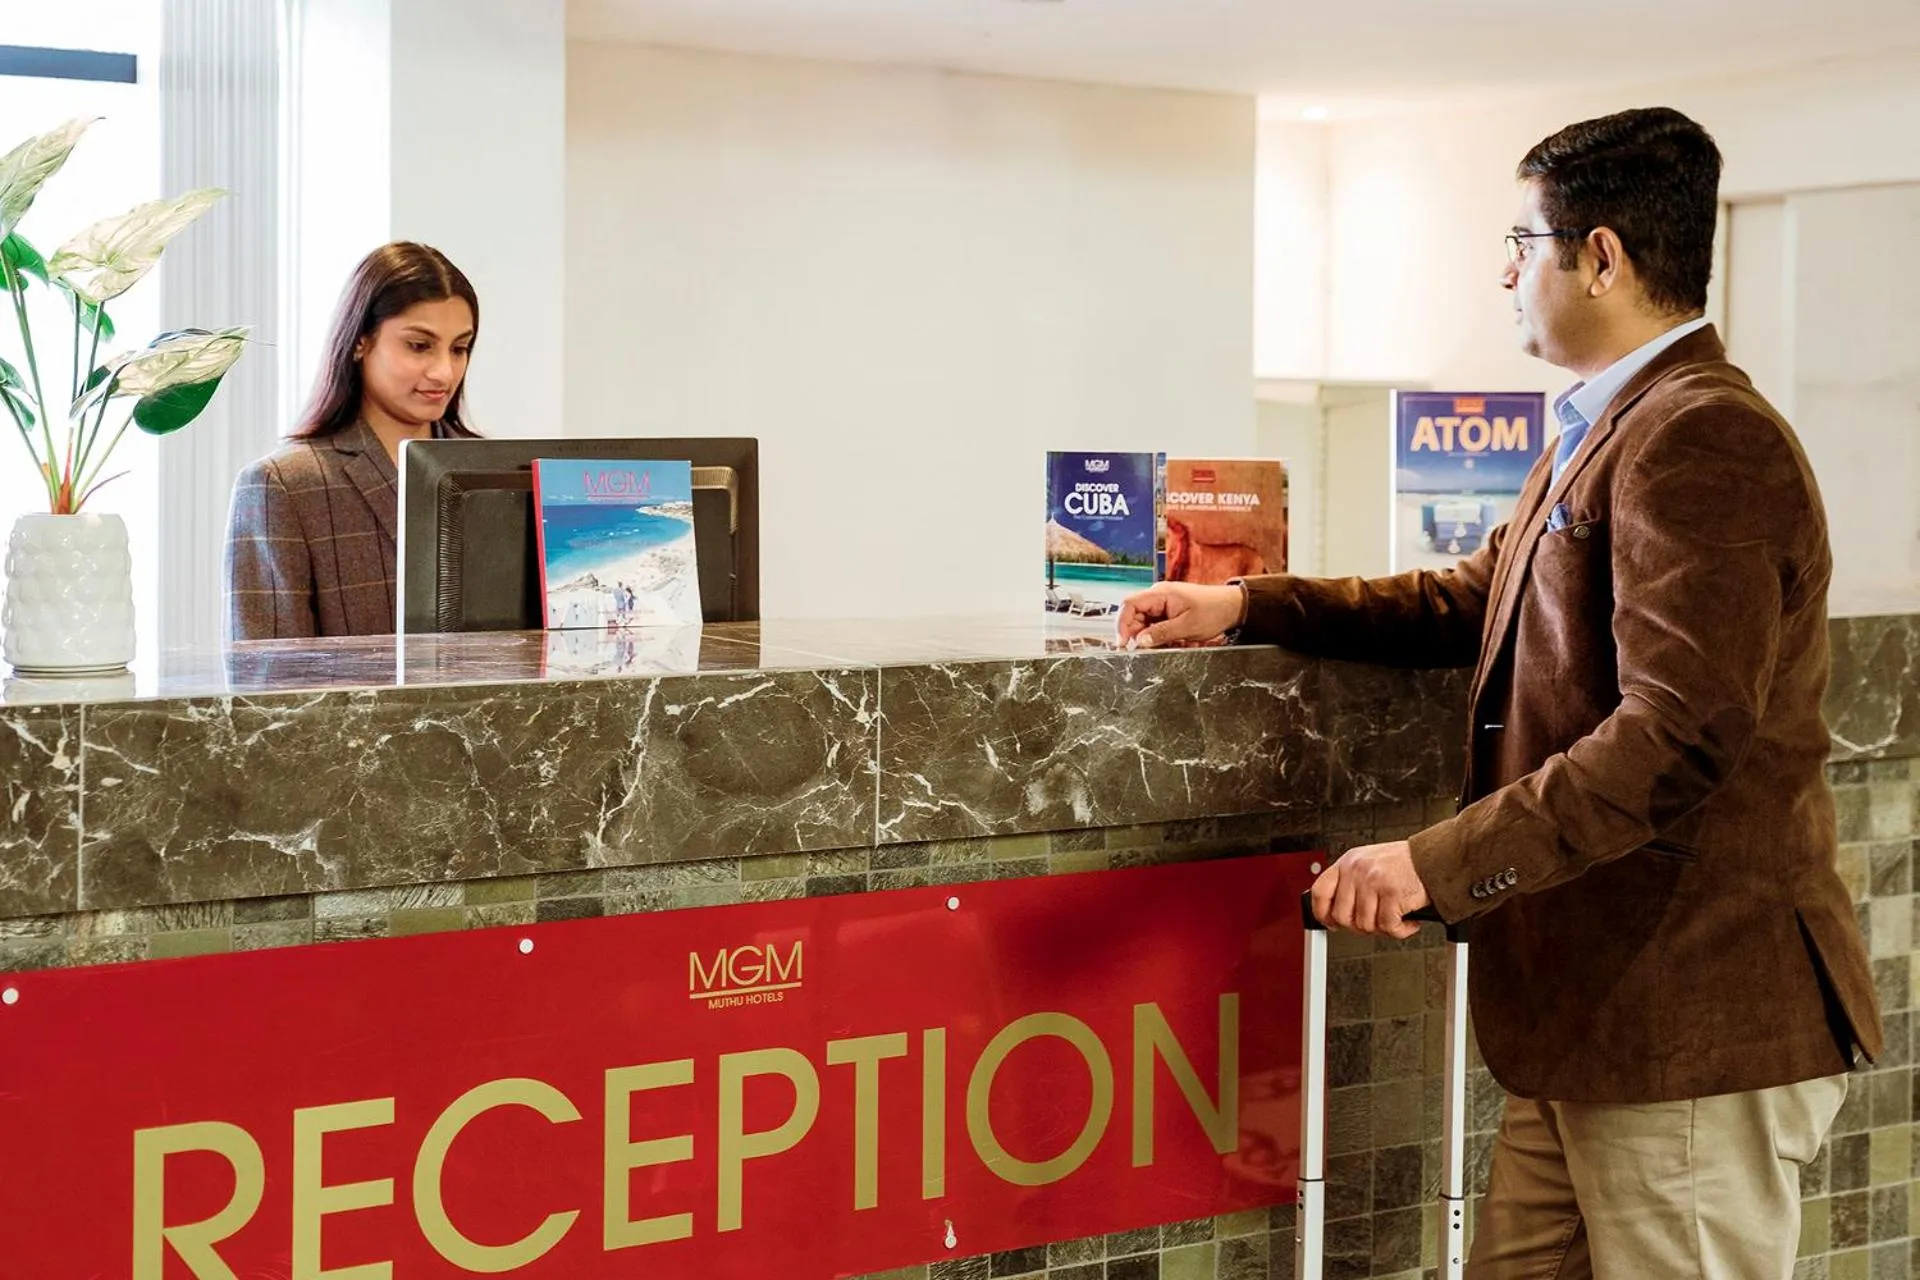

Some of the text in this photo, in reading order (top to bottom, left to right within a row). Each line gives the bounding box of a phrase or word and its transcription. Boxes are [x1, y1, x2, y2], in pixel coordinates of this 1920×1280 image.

[1410, 416, 1529, 452] ATOM
[583, 471, 650, 494] MGM
[1075, 483, 1119, 494] DISCOVER
[1064, 492, 1130, 515] CUBA
[1217, 492, 1261, 505] KENYA
[689, 940, 803, 992] MGM
[707, 991, 784, 1010] MUTHU HOTELS
[132, 992, 1241, 1280] RECEPTION
